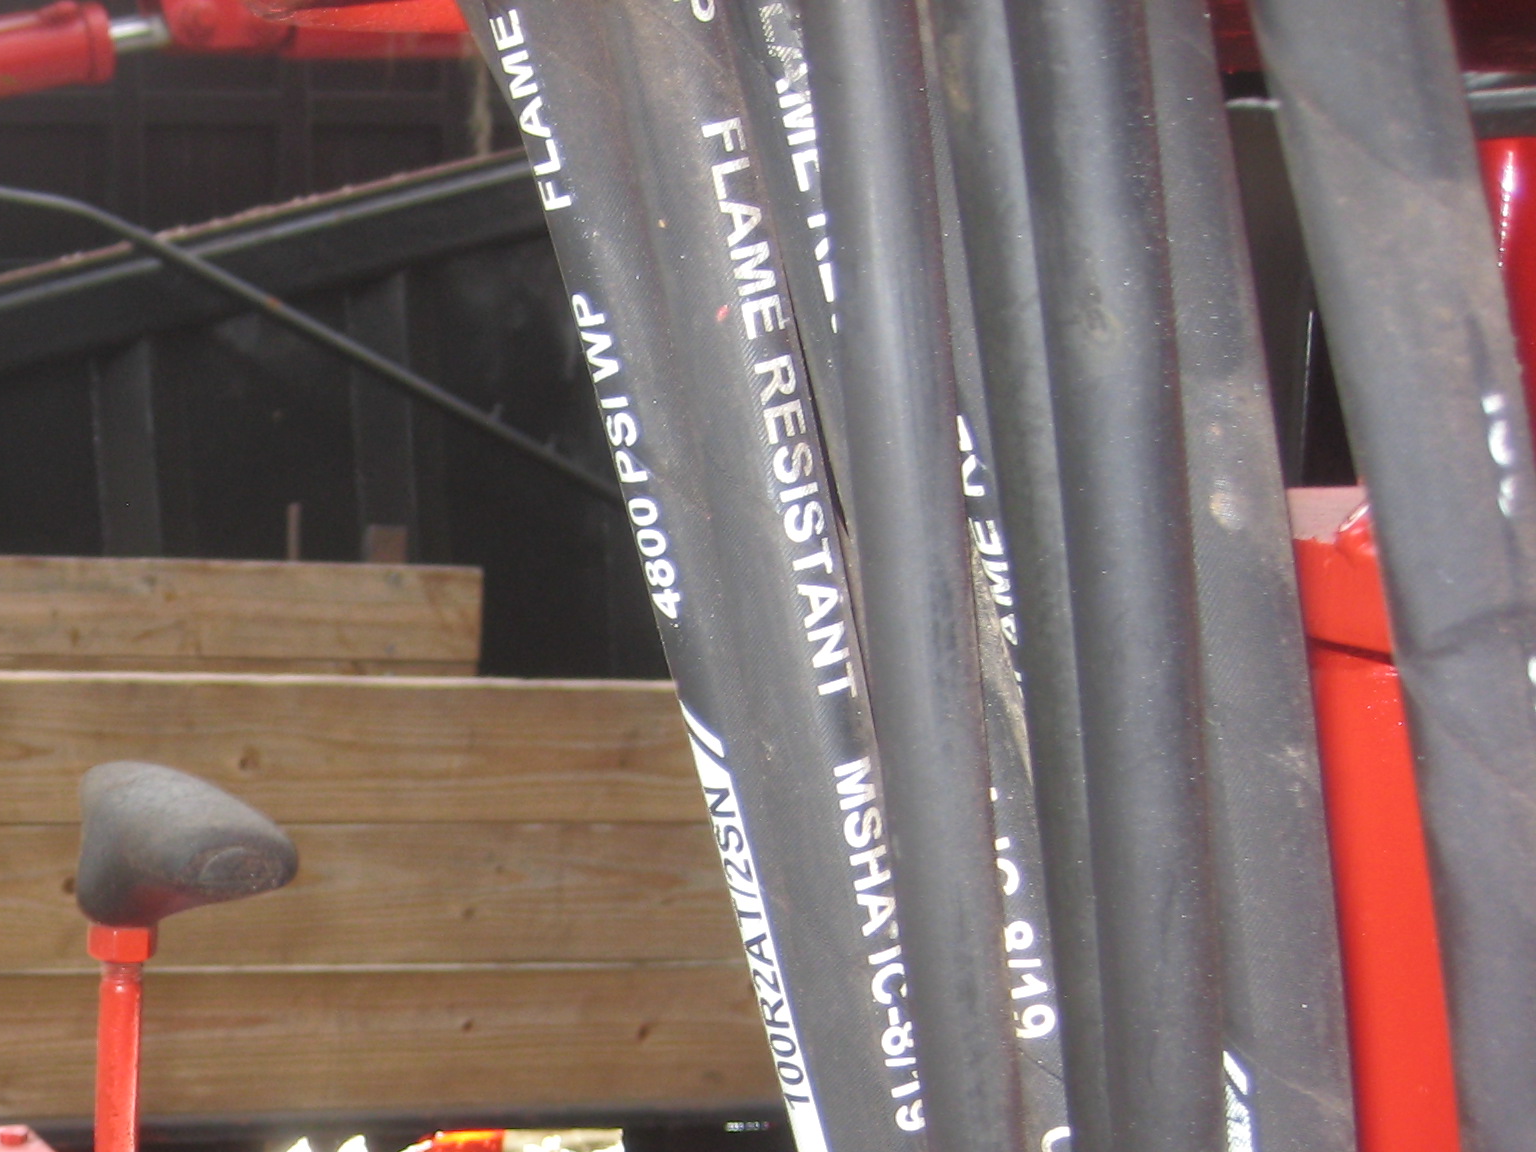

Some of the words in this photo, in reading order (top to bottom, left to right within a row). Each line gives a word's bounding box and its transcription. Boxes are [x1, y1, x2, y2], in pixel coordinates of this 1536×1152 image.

[489, 8, 572, 211] FLAME
[572, 294, 620, 383] WP
[601, 396, 649, 484] PSI
[629, 497, 680, 620] 4800
[701, 116, 787, 340] FLAME
[754, 354, 858, 698] RESISTANT
[833, 755, 898, 937] MSHA
[704, 784, 812, 1109] 100R2AT/2SN
